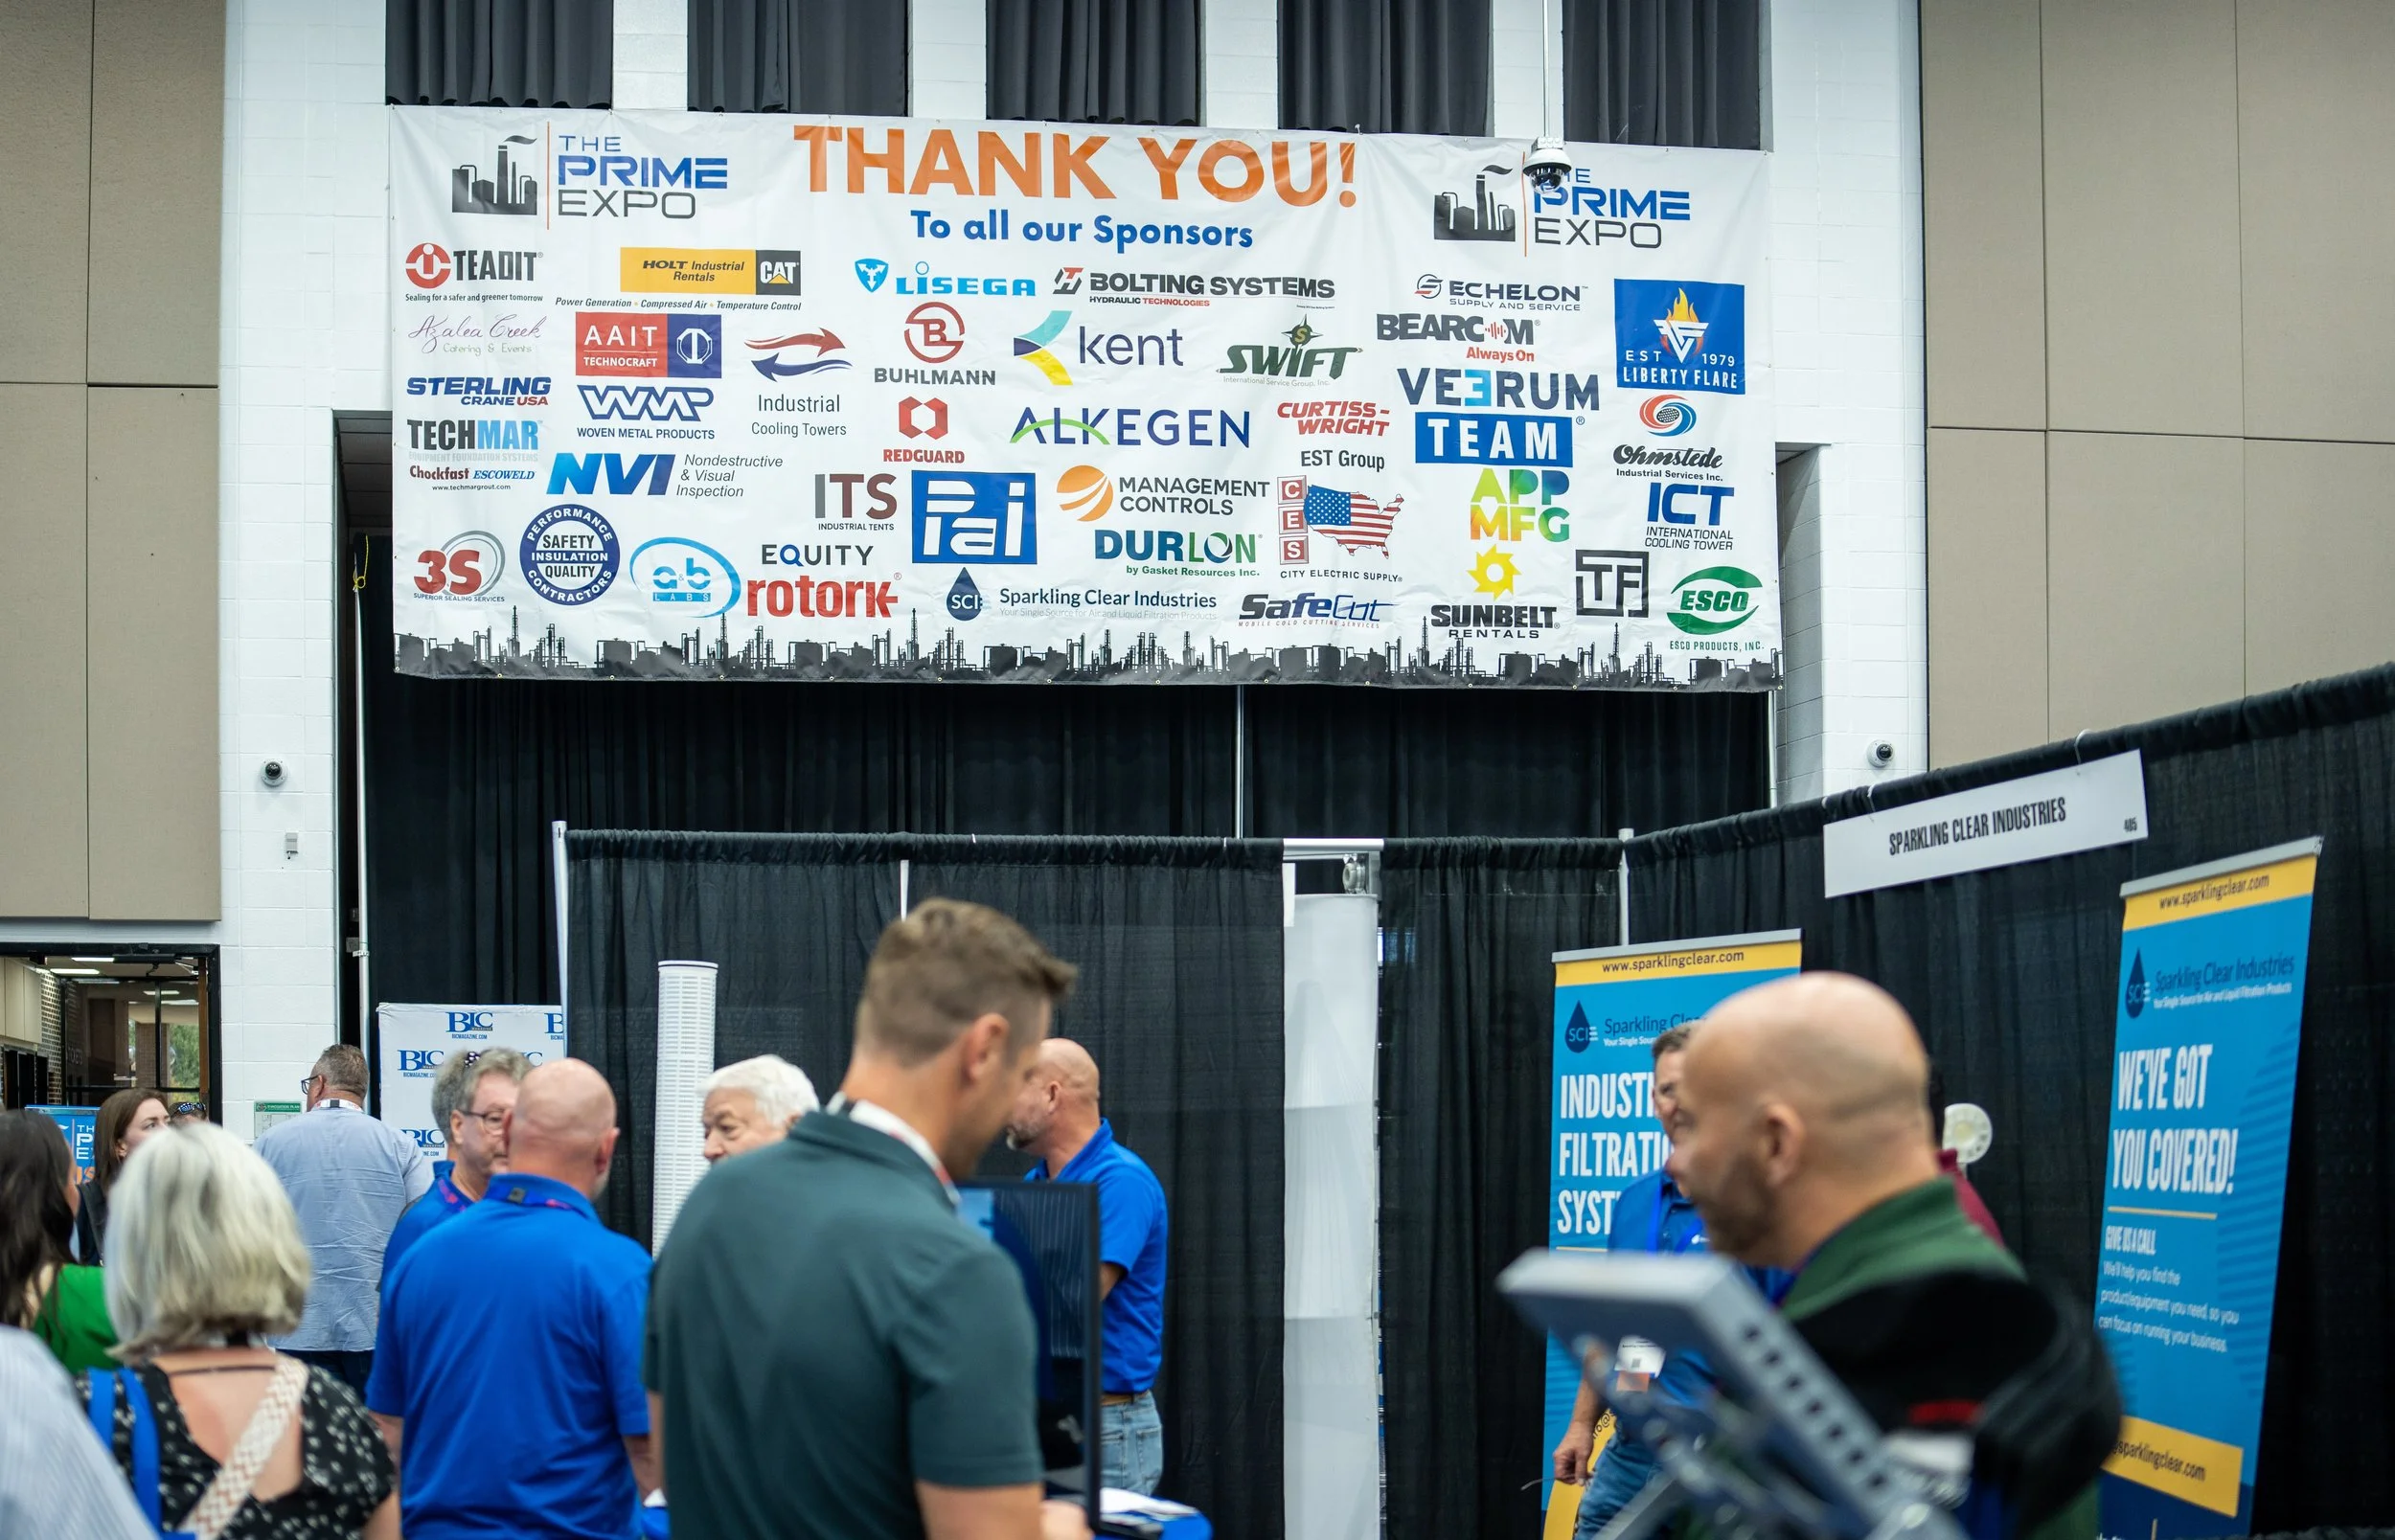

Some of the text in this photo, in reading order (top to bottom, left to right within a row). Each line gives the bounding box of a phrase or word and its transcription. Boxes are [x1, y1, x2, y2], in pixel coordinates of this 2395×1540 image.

[558, 135, 622, 152] THE
[559, 155, 728, 189] PRIME
[793, 125, 1357, 208] THANK YOU!
[559, 190, 696, 219] EXPO
[1535, 186, 1690, 220] PRIME
[910, 209, 1253, 254] To all our Sponsors
[1535, 217, 1662, 249] EXPO
[643, 260, 744, 272] HOLT Industrial
[761, 260, 799, 284] CAT
[673, 271, 715, 283] Rentals
[1090, 272, 1335, 299] BOLTING SYSTEMS
[405, 293, 431, 303] Sealing
[432, 293, 443, 302] for
[448, 293, 467, 302] safer
[467, 293, 481, 302] and
[481, 295, 508, 304] greener
[509, 294, 543, 303] tomorrow
[1089, 295, 1210, 306] HYDRAULIC TECHNOLOGIES
[1449, 281, 1581, 302] ECHELON
[556, 297, 801, 311] Power Generation Compressed Air Temperature Control
[1449, 299, 1581, 311] SUPPLY AND SERVICE
[408, 313, 547, 353] Azalea Creek
[583, 325, 657, 347] AAIT
[444, 343, 532, 356] Catering & Events
[1080, 326, 1184, 366] kent
[1466, 346, 1535, 363] Always On
[583, 356, 657, 369] TECHNOCRAFT
[1216, 345, 1363, 380] SWIFT
[1626, 350, 1735, 367] EST 1979
[406, 376, 552, 396] STERLING
[874, 368, 996, 386] BUHLMANN
[1623, 367, 1738, 389] LIBERTY FLARE
[461, 396, 549, 406] CRANE USA
[758, 394, 841, 413] Industrial
[407, 419, 539, 451] TECHMAR
[577, 427, 715, 440] WOVEN METAL PRODUCTS
[751, 421, 847, 438] Cooling Towers
[1010, 406, 1250, 448] ALKEGEN
[1297, 419, 1390, 437] WRIGHT
[1427, 418, 1558, 461] TEAM
[409, 450, 538, 462] EQUIPMENT FOUNDATION SYSTEMS
[684, 454, 784, 468] Nondestructive
[882, 448, 966, 464] REDGUARD
[1300, 449, 1385, 472] EST Group
[1613, 444, 1722, 469] Ohmstede
[409, 464, 535, 480] Chockfast ESCOWELD
[546, 453, 676, 496] NVI
[680, 469, 736, 482] & Visual
[1616, 468, 1723, 482] Industrial Services Inc.
[676, 484, 744, 500] Inspection
[814, 473, 898, 520] ITS
[1119, 476, 1270, 498] MANAGEMENT
[1471, 467, 1570, 506] APP
[1120, 495, 1234, 515] CONTROLS
[1647, 482, 1735, 527] ICT
[526, 508, 613, 543] PERFORMANCE
[818, 523, 895, 532] INDUSTRIAL TENTS
[1470, 504, 1570, 542] MFG
[1646, 526, 1734, 540] INTERNATIONAL
[542, 534, 595, 550] SAFETY
[1094, 529, 1257, 564] DURLON
[1644, 537, 1734, 551] COOLING TOWER
[531, 552, 608, 562] INSULATION
[762, 544, 874, 567] EQUITY
[413, 549, 483, 596] 3S
[544, 565, 596, 578] QUALITY
[1126, 565, 1261, 578] by Gasket Resources Inc.
[1280, 570, 1306, 579] CITY
[1310, 570, 1359, 579] ELECTRIC
[528, 569, 612, 602] CONTRACTORS
[413, 592, 443, 601] SUPERIOR
[474, 595, 506, 603] SERVICES
[746, 575, 899, 619] rotork
[1000, 588, 1218, 608] Sparkling Clear Industries
[1239, 592, 1399, 623] SafeCut
[1680, 590, 1749, 612] ESCO
[1430, 604, 1557, 628] SUNBELT
[1449, 629, 1540, 640] RENTALS
[1669, 640, 1765, 652] ESCO PRODUCTS, INC.
[1889, 797, 2066, 856] SPARKLING CLEAR INDUSTRIES
[2159, 873, 2270, 910] www.sparklingclear.com
[1602, 949, 1745, 973] www.sparklingclear.com
[445, 1011, 493, 1032] BIC
[1604, 1015, 1668, 1036] Sparkling
[398, 1050, 445, 1072] BIC
[2118, 1044, 2214, 1112] WE'VE GOT
[2112, 1128, 2239, 1195] YOU COVERED!
[1557, 1189, 1622, 1235] SYST
